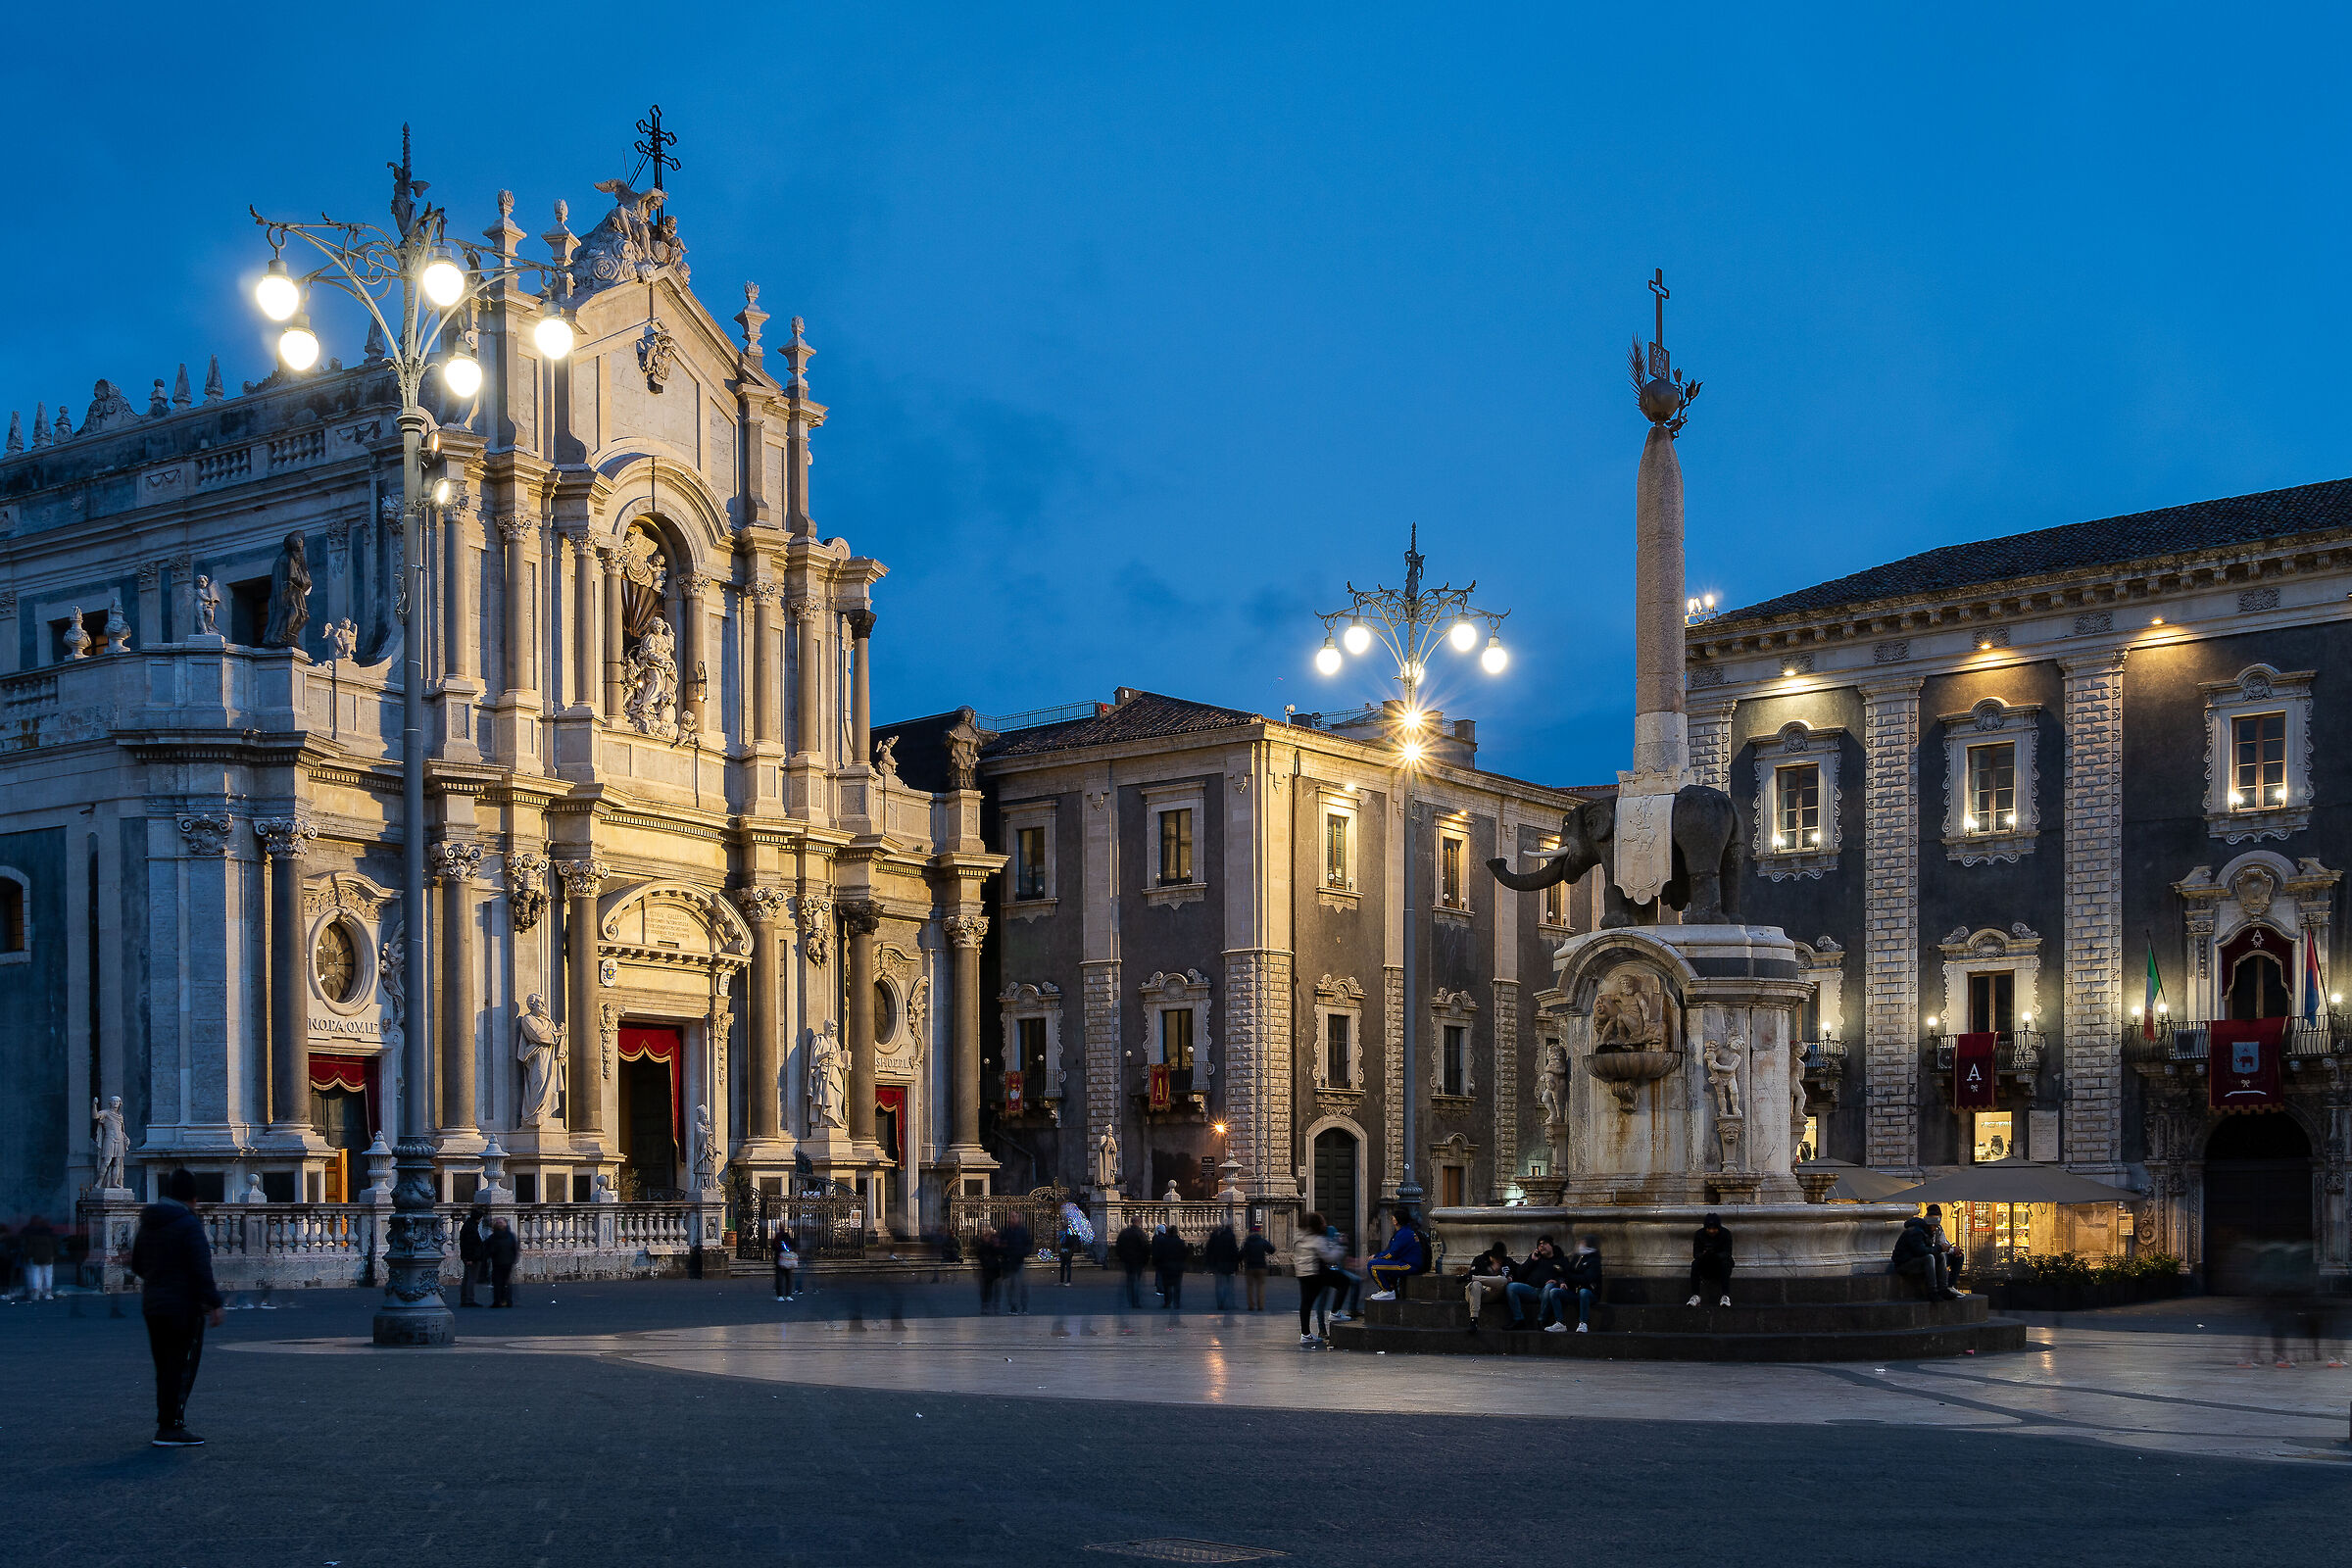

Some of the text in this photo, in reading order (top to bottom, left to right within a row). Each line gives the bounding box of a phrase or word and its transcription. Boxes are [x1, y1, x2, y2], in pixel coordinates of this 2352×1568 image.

[2250, 929, 2265, 942] A
[1966, 1063, 1983, 1082] A
[1154, 1077, 1164, 1101] A
